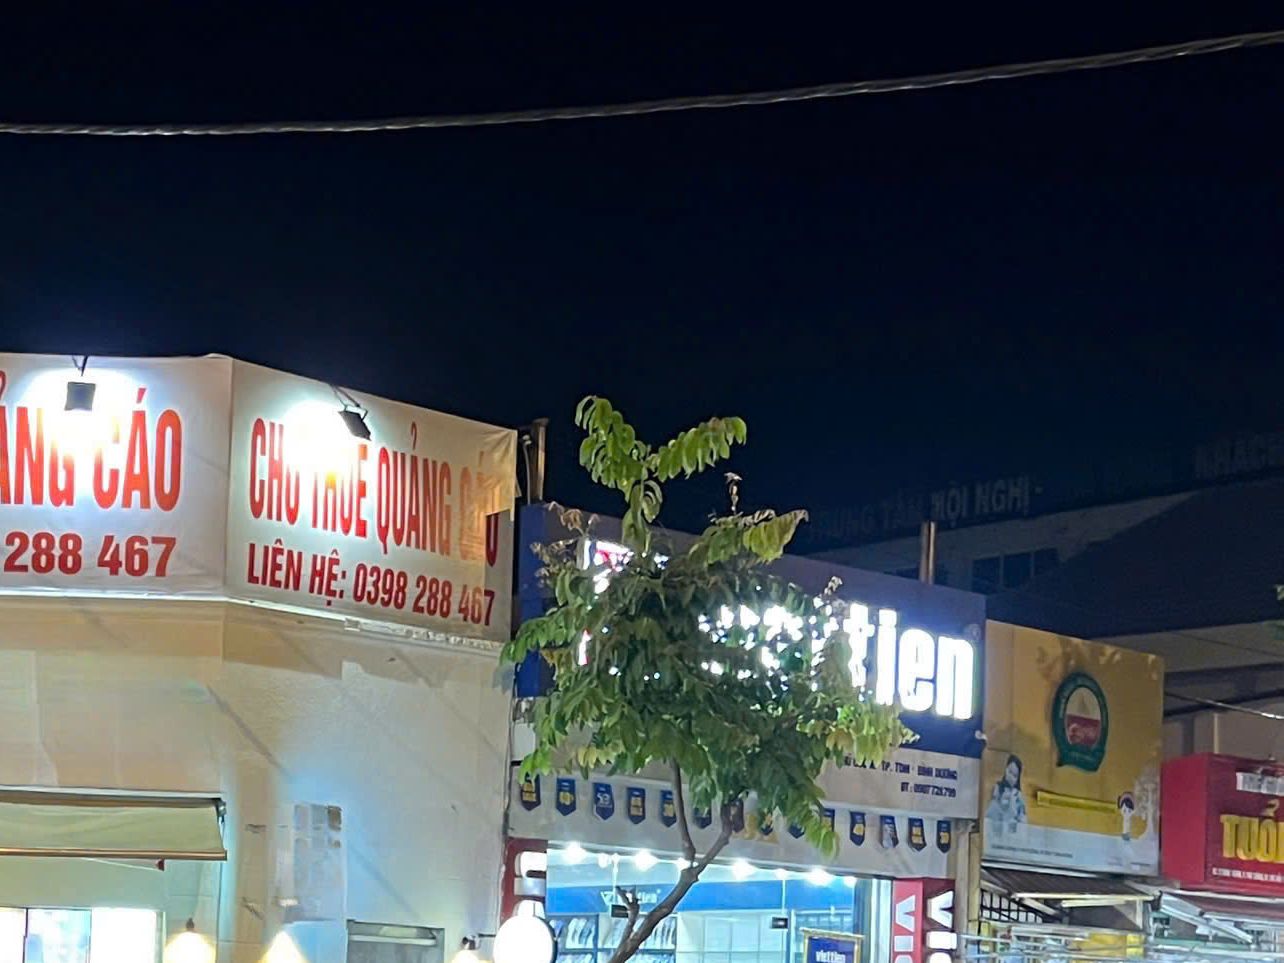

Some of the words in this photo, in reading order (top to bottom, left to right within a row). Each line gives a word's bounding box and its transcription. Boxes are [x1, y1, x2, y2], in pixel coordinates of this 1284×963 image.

[93, 387, 182, 512] CÁO
[376, 420, 452, 556] QUẢNG
[976, 474, 1030, 516] NGHỊ
[4, 531, 83, 575] 288
[97, 534, 177, 578] 467
[248, 538, 302, 591] LIÊN
[309, 548, 346, 606] HỆ:
[353, 563, 408, 610] 0398
[413, 575, 452, 619] 288
[458, 584, 495, 626] 467
